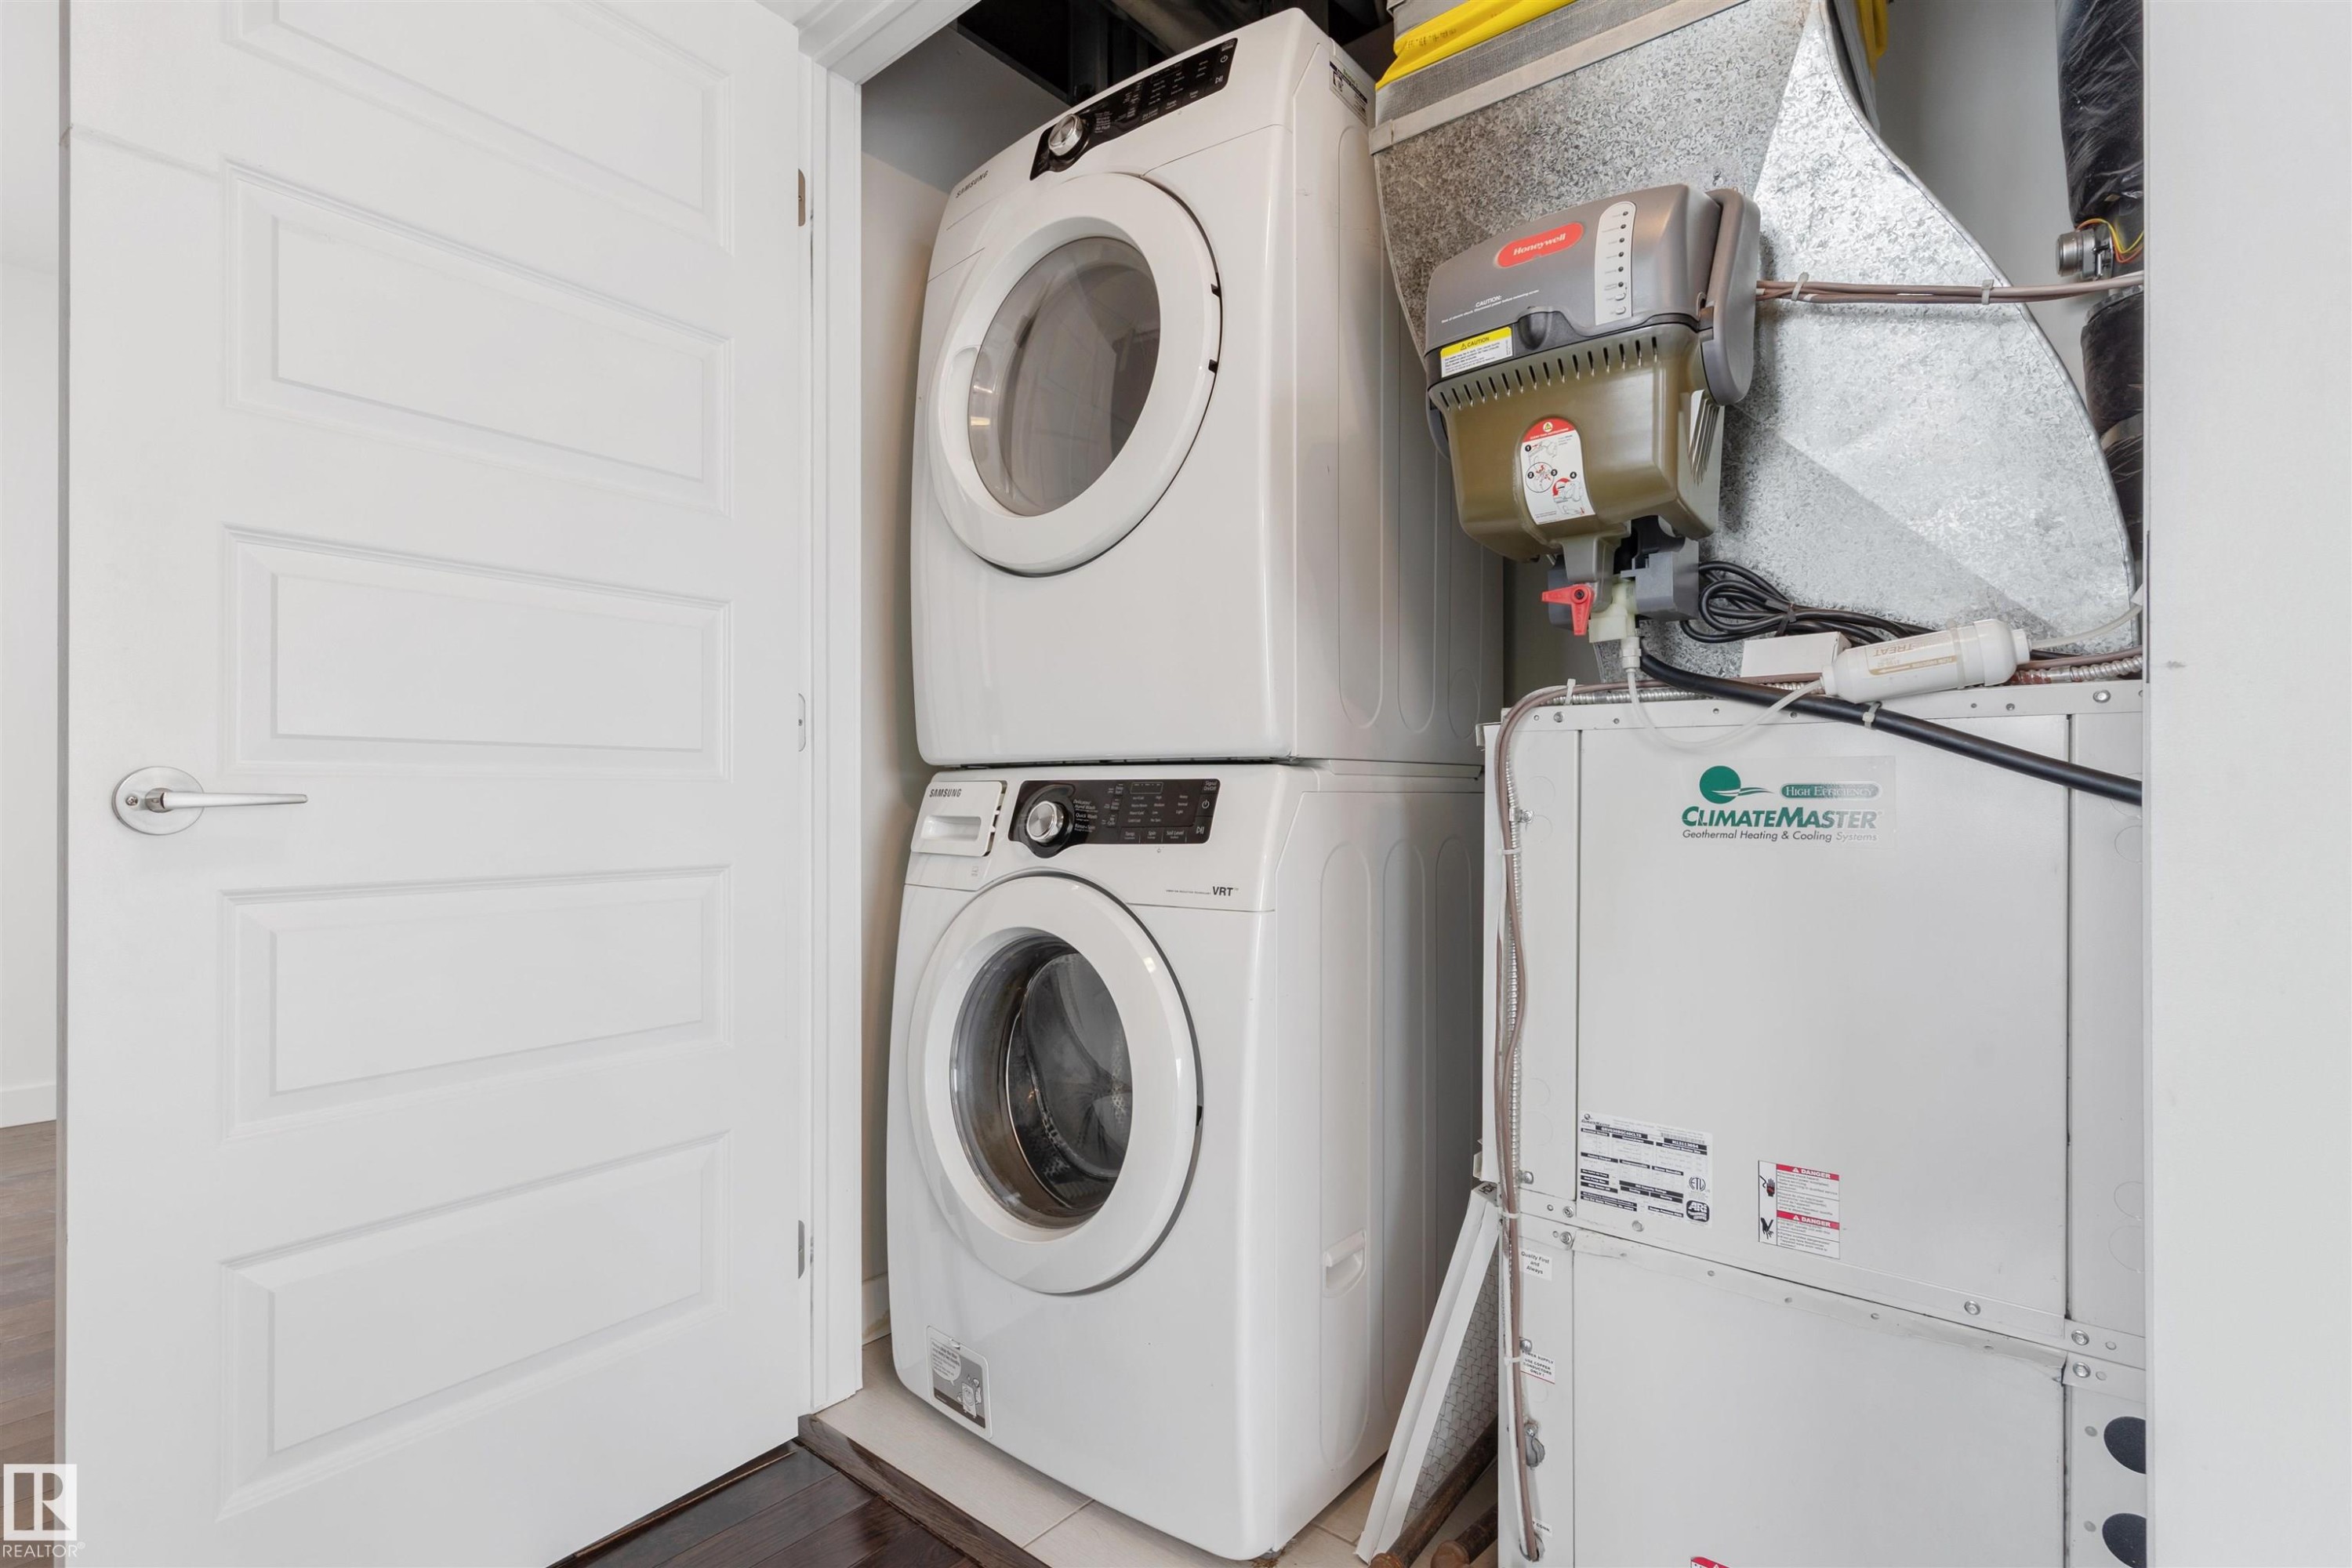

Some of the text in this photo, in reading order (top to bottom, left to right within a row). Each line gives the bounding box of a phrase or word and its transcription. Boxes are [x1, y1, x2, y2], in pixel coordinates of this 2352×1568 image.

[956, 170, 989, 198] SAMSUNG
[1513, 233, 1566, 256] Honeywell
[1475, 295, 1502, 308] CAUTION:
[1467, 336, 1490, 347] CAUTION
[929, 789, 962, 797] SAMSUNG
[1682, 829, 1877, 843] Geothermal Heating & Cooling Systems
[1801, 1168, 1831, 1179] DANGER
[1801, 1217, 1831, 1227] DANGER
[1521, 1251, 1537, 1260] Quality
[1526, 1265, 1543, 1274] Always
[1534, 1361, 1551, 1370] COPPER
[1537, 1356, 1554, 1364] SUPPLY
[1523, 1362, 1552, 1375] CONDUCTORS
